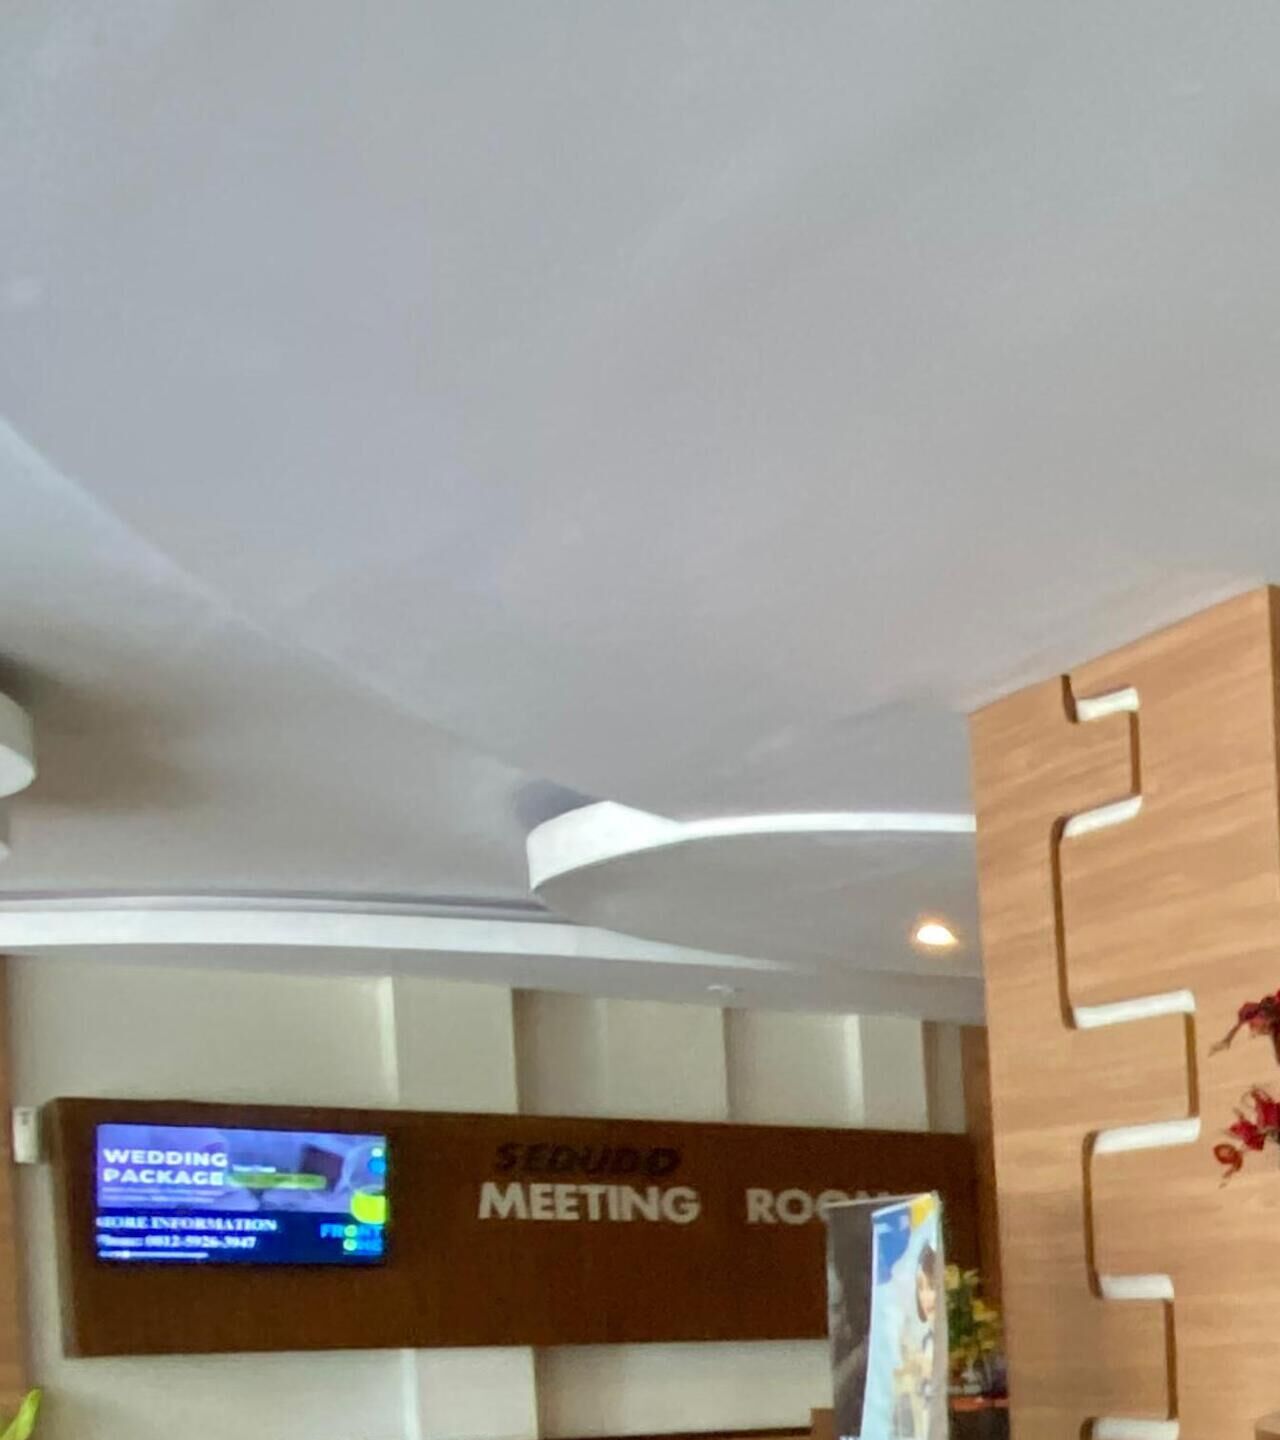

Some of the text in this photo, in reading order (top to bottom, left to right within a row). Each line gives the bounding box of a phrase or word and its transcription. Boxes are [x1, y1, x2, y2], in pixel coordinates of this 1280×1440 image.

[103, 1149, 229, 1166] WEDDING
[103, 1168, 225, 1186] PACKAGE
[478, 1181, 701, 1224] MEETING
[152, 1217, 278, 1232] INFORMATION
